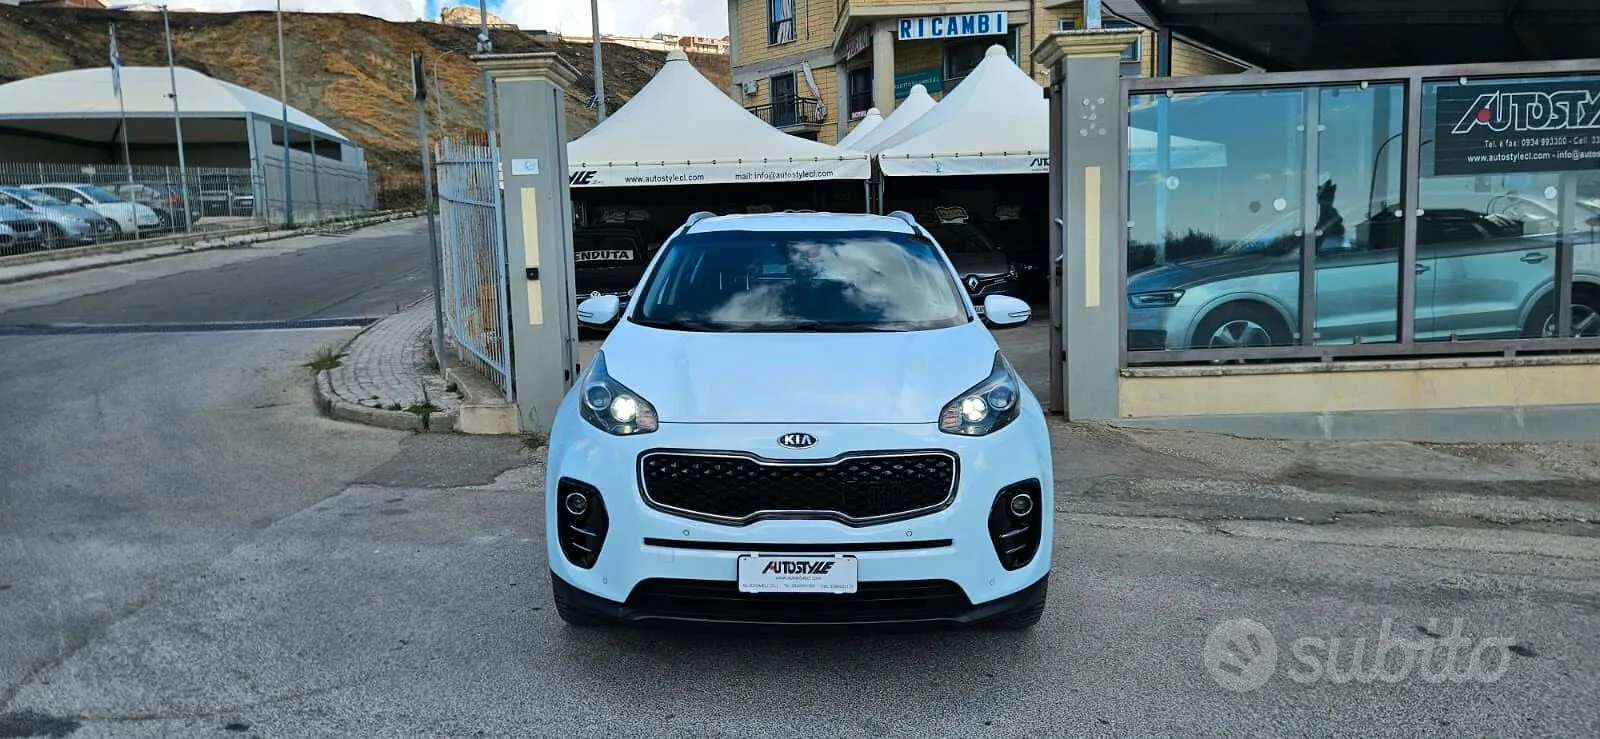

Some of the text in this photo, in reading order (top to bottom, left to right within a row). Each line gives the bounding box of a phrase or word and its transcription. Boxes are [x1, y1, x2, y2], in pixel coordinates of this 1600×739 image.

[900, 13, 1002, 38] RICAMBI
[1521, 137, 1539, 147] 0934
[1467, 152, 1551, 163] www.autostylecl.com
[624, 173, 705, 184] www.autostylecl.com
[784, 434, 812, 445] KIA
[762, 561, 836, 575] AUTOSTYLE
